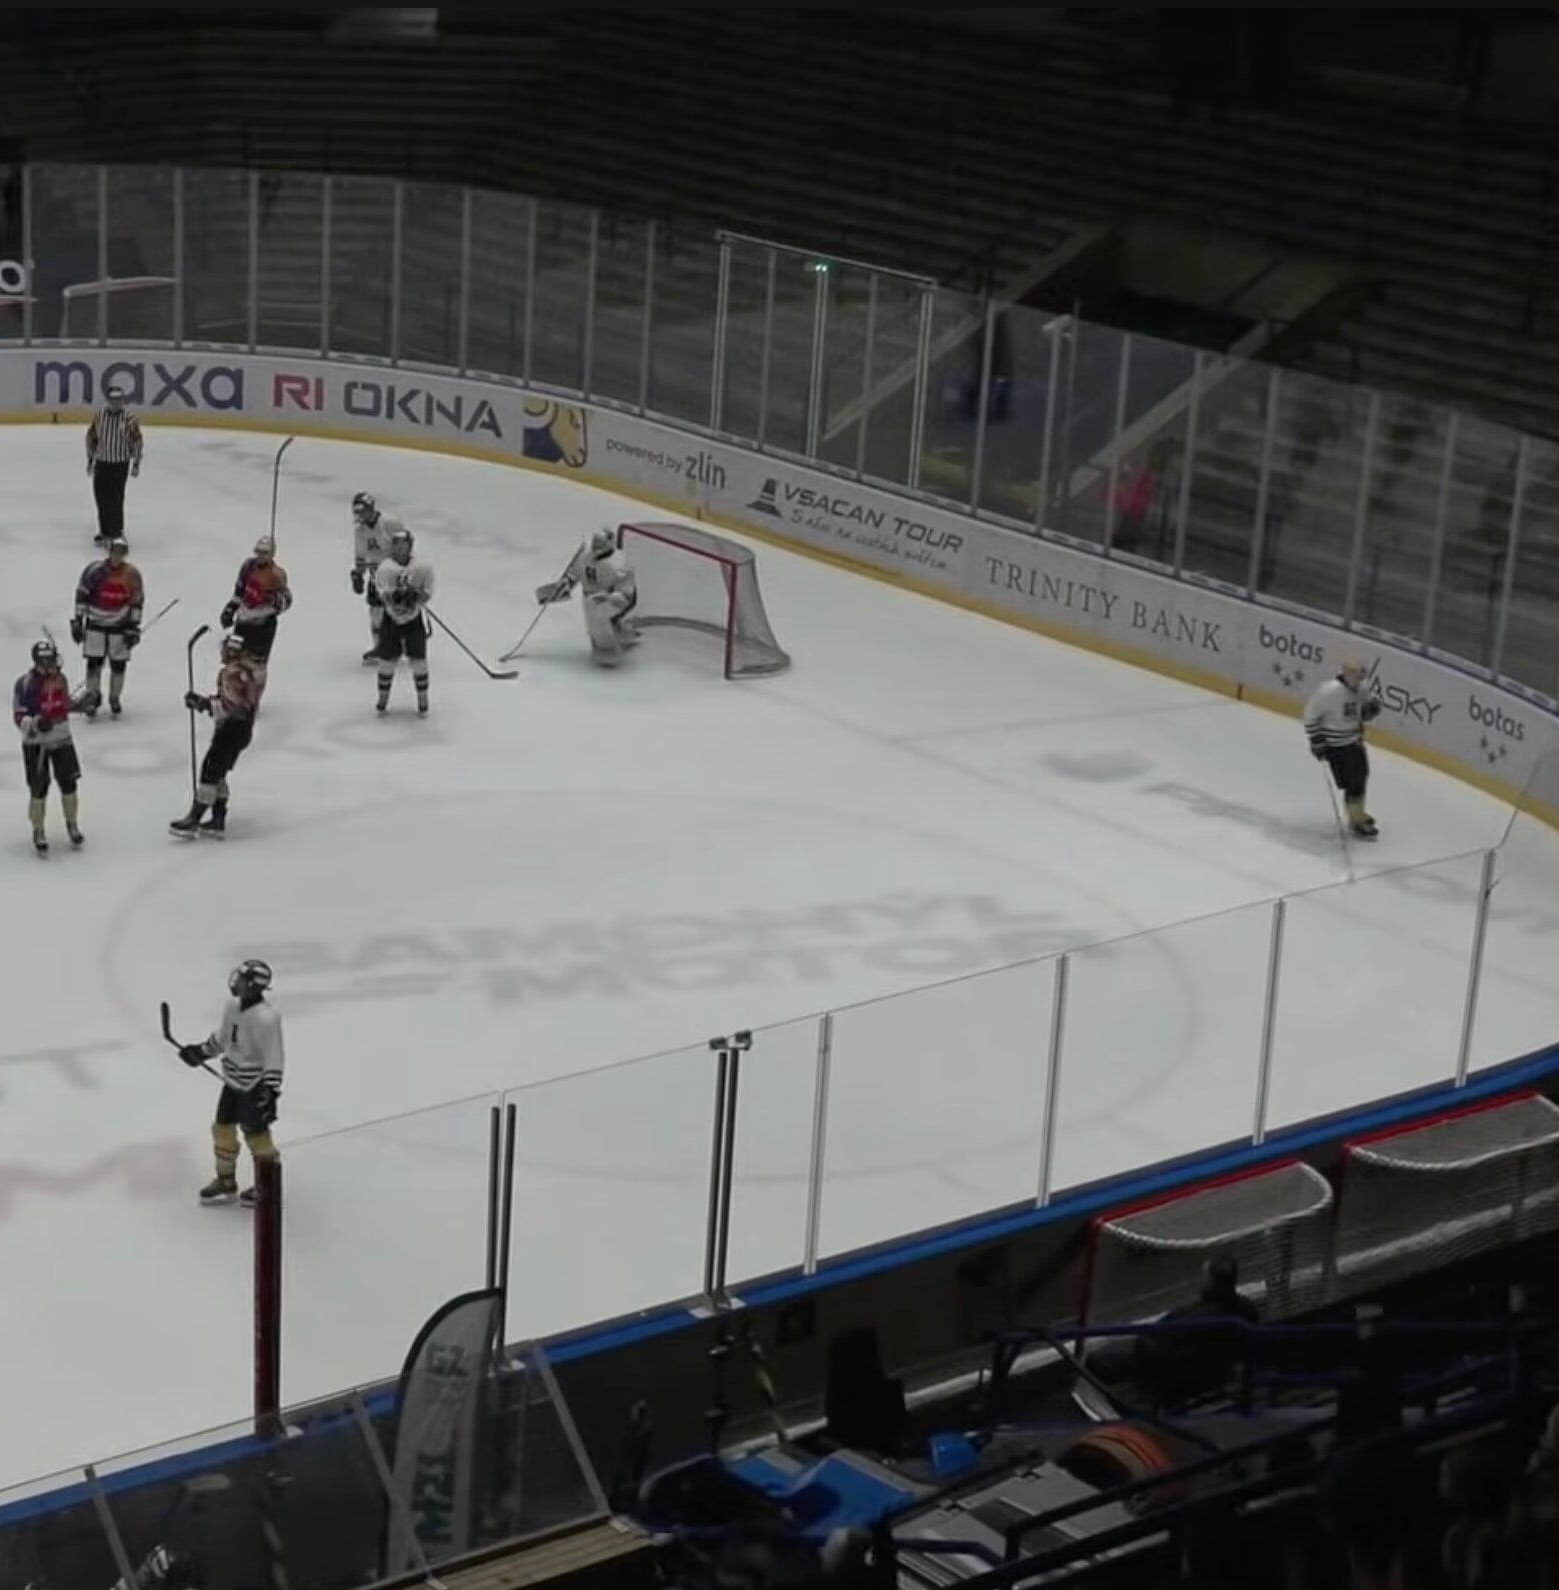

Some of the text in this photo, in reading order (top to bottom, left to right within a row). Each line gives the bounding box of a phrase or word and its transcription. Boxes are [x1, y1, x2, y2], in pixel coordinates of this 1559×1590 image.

[36, 361, 243, 409] maxa
[274, 373, 502, 438] RI OKNA
[606, 437, 726, 489] powered by zlin
[786, 484, 963, 554] VSACAN TOUR
[986, 557, 1222, 652] TRINITY BANK
[1259, 624, 1324, 664] botas
[1469, 695, 1526, 741] botas
